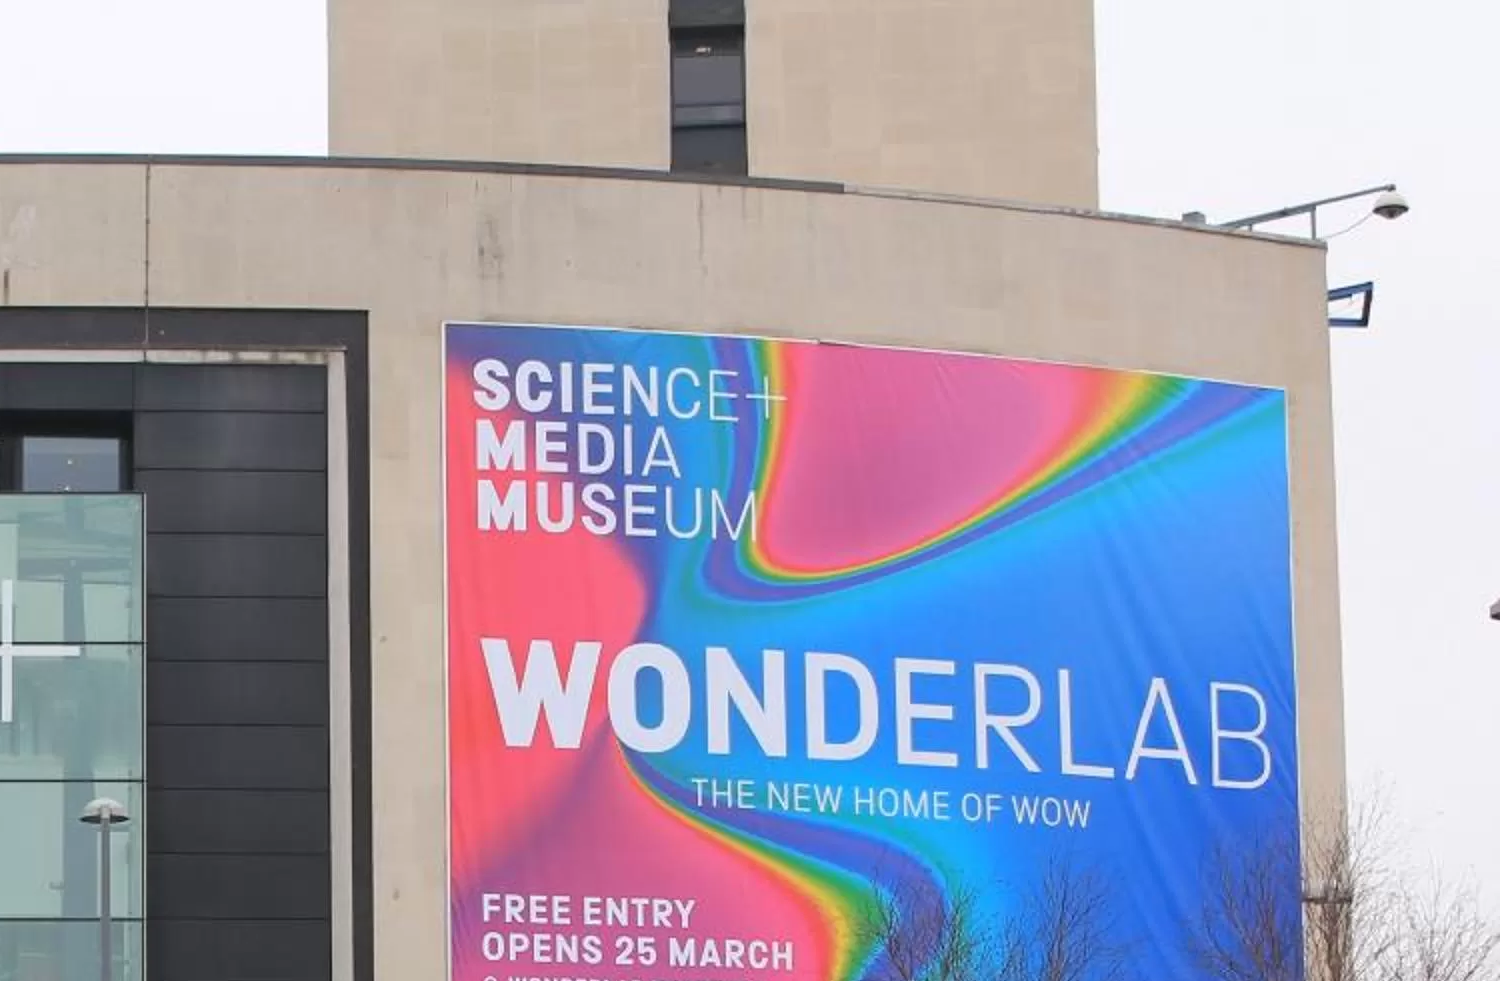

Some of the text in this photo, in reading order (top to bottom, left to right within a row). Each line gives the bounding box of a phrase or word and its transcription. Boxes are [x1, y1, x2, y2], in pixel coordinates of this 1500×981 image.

[473, 358, 788, 422] SCIENCE+
[474, 418, 682, 479] MEDIA
[475, 479, 759, 542] MUSEUM
[480, 635, 1274, 791] WONDERLAB
[693, 778, 1092, 829] THE NEW HOME OF WOW
[482, 893, 697, 929] FREE ENTRY
[481, 931, 794, 971] OPENS 25 MARCH
